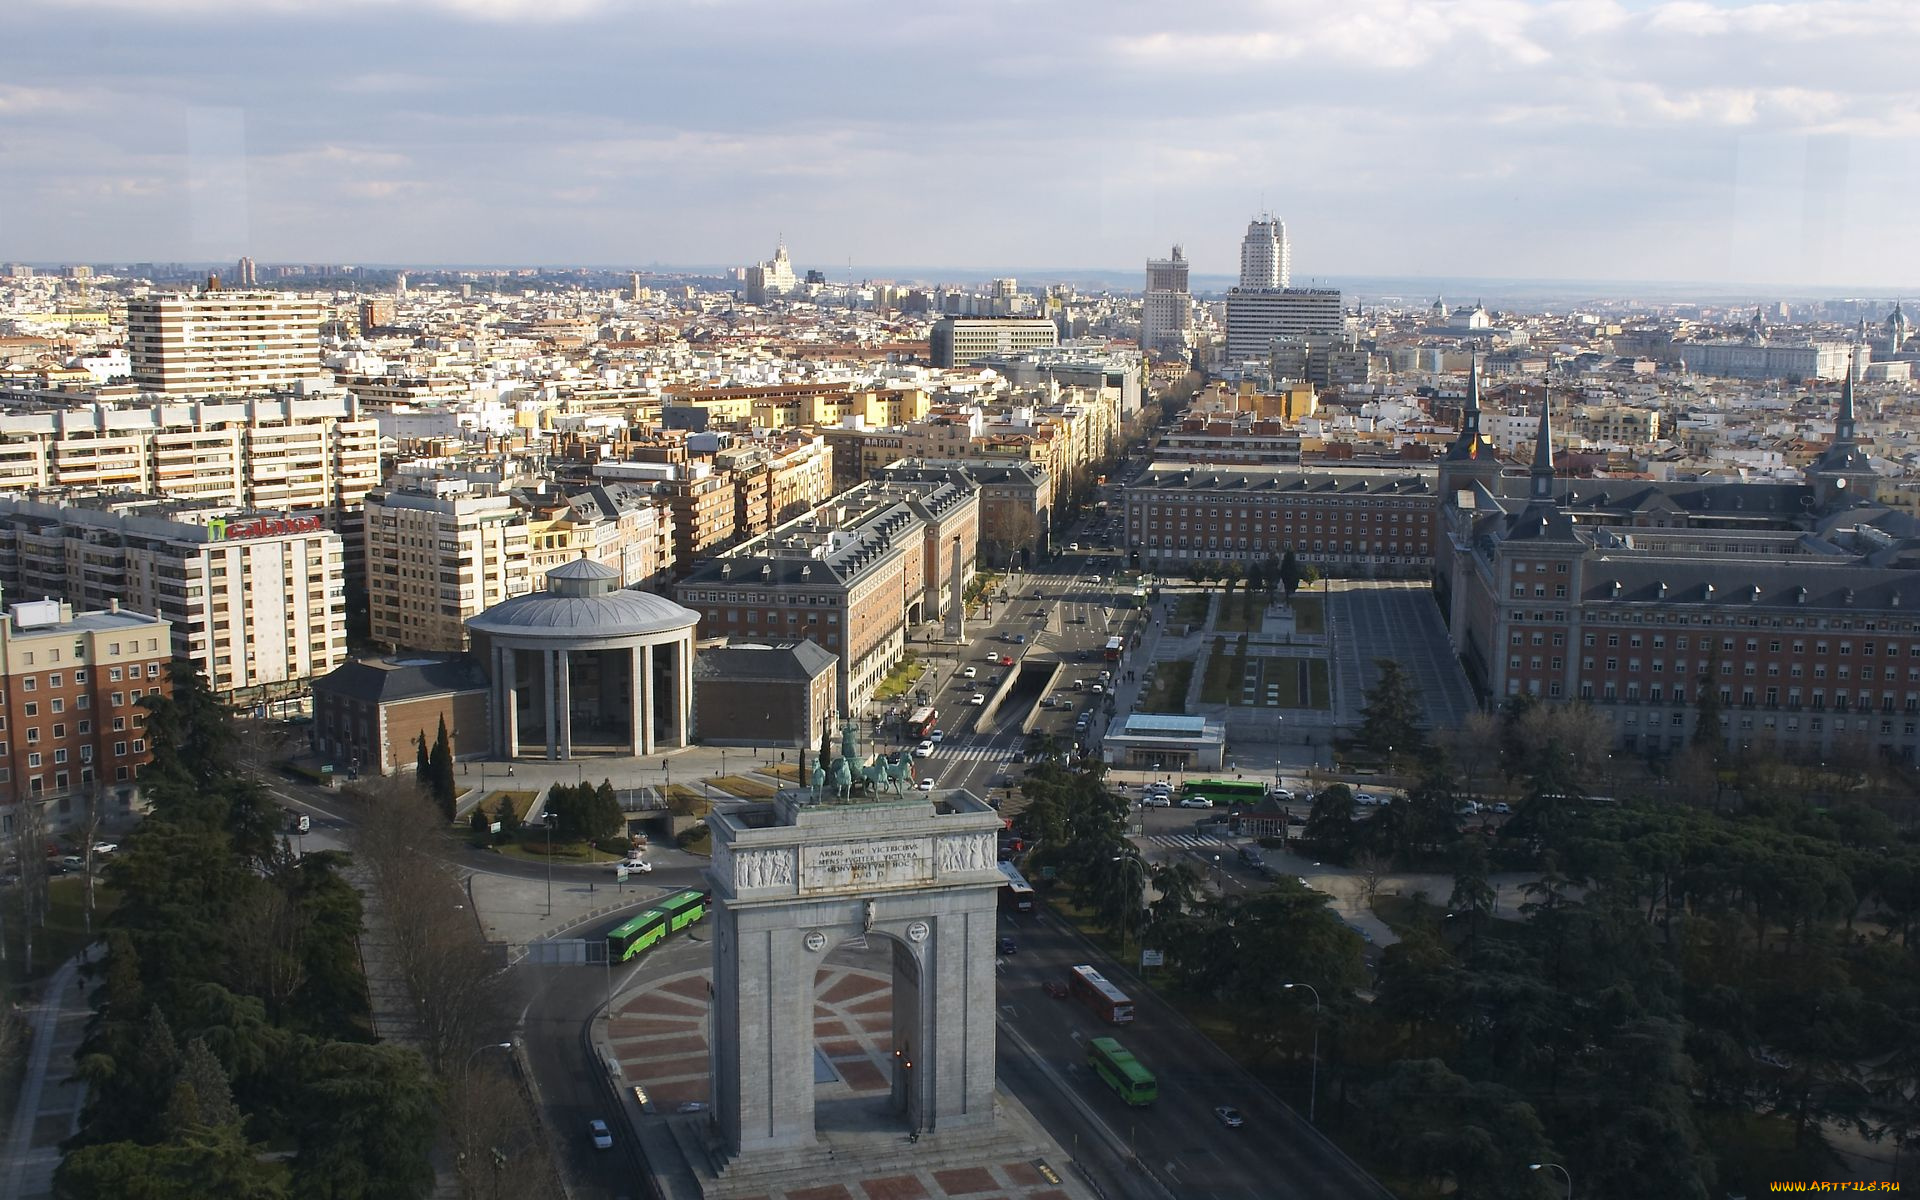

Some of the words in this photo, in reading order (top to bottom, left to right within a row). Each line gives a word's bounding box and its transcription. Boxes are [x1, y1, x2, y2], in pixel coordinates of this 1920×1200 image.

[1283, 287, 1308, 295] Madrid
[819, 849, 844, 857] ARMIS
[851, 847, 864, 855] HIC
[818, 858, 840, 866] MENS
